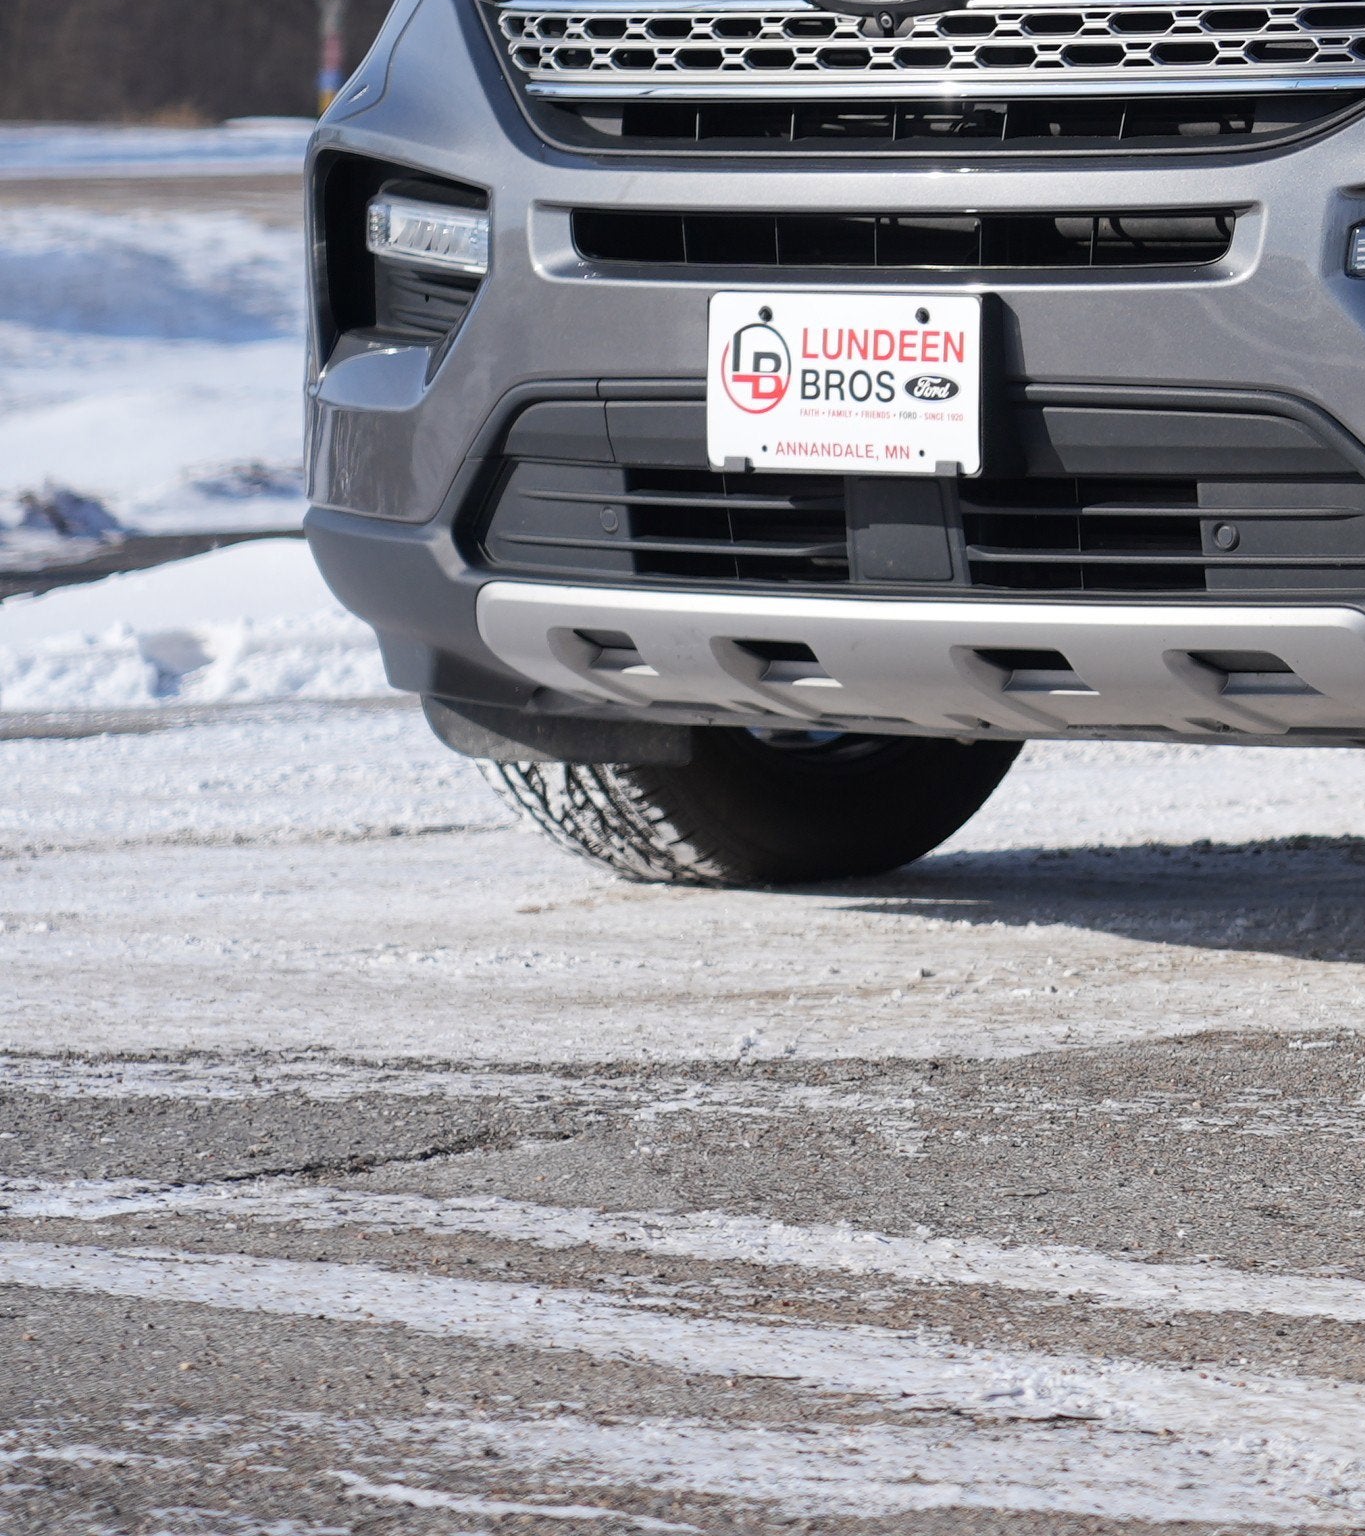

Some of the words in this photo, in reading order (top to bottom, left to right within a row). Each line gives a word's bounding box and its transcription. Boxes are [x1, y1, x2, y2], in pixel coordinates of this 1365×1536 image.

[802, 328, 964, 363] LUNDEEN
[801, 369, 895, 402] BROS
[913, 376, 951, 398] Ford
[800, 408, 820, 417] FAITH
[828, 409, 852, 418] FAMILY
[861, 410, 890, 419] FRIENDS
[899, 411, 917, 420] FORD
[924, 412, 943, 421] SINCE
[776, 442, 879, 460] ANNANDALE,
[886, 444, 910, 459] MN
